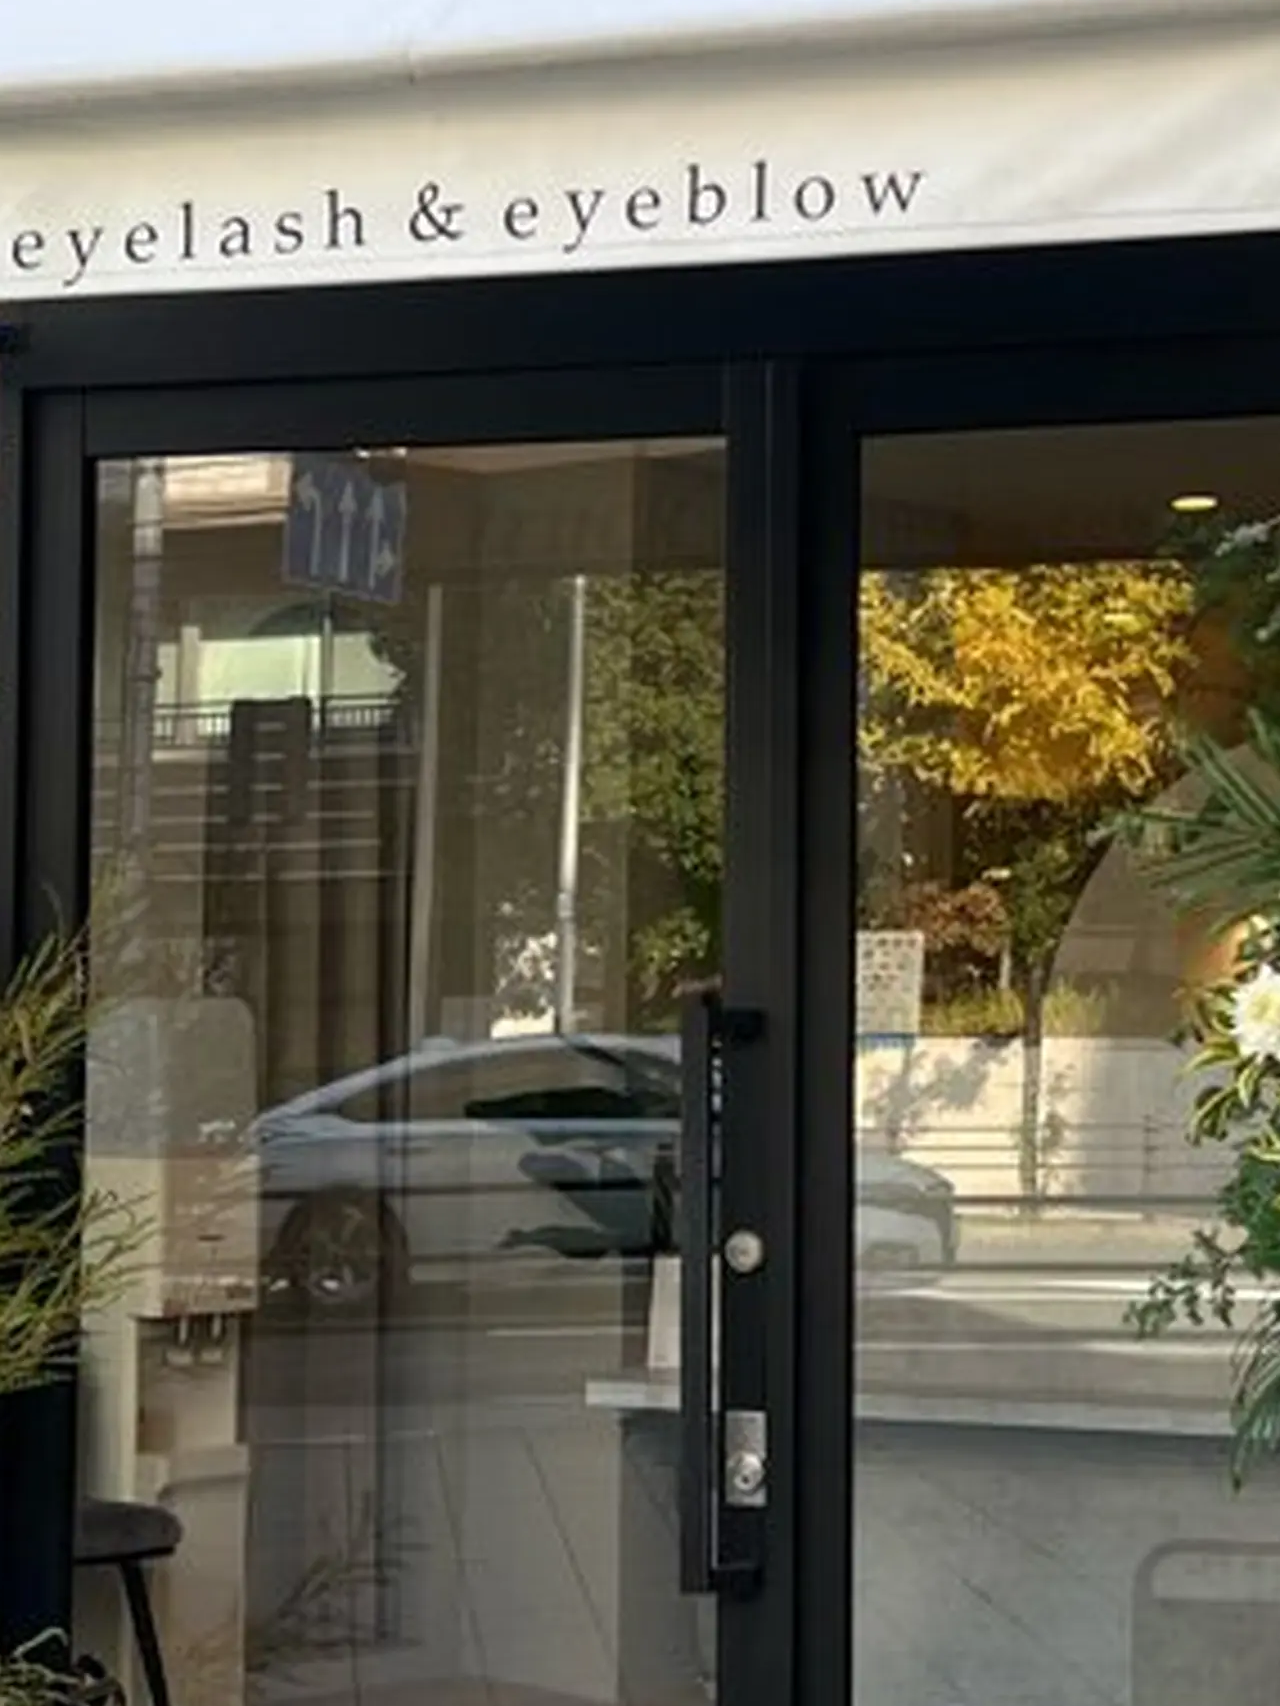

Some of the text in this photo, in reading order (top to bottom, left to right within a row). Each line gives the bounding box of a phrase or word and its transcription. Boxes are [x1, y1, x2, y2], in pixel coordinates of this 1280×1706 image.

[10, 188, 366, 285] eyelash
[407, 181, 466, 243] &
[502, 159, 924, 251] eyeblow
